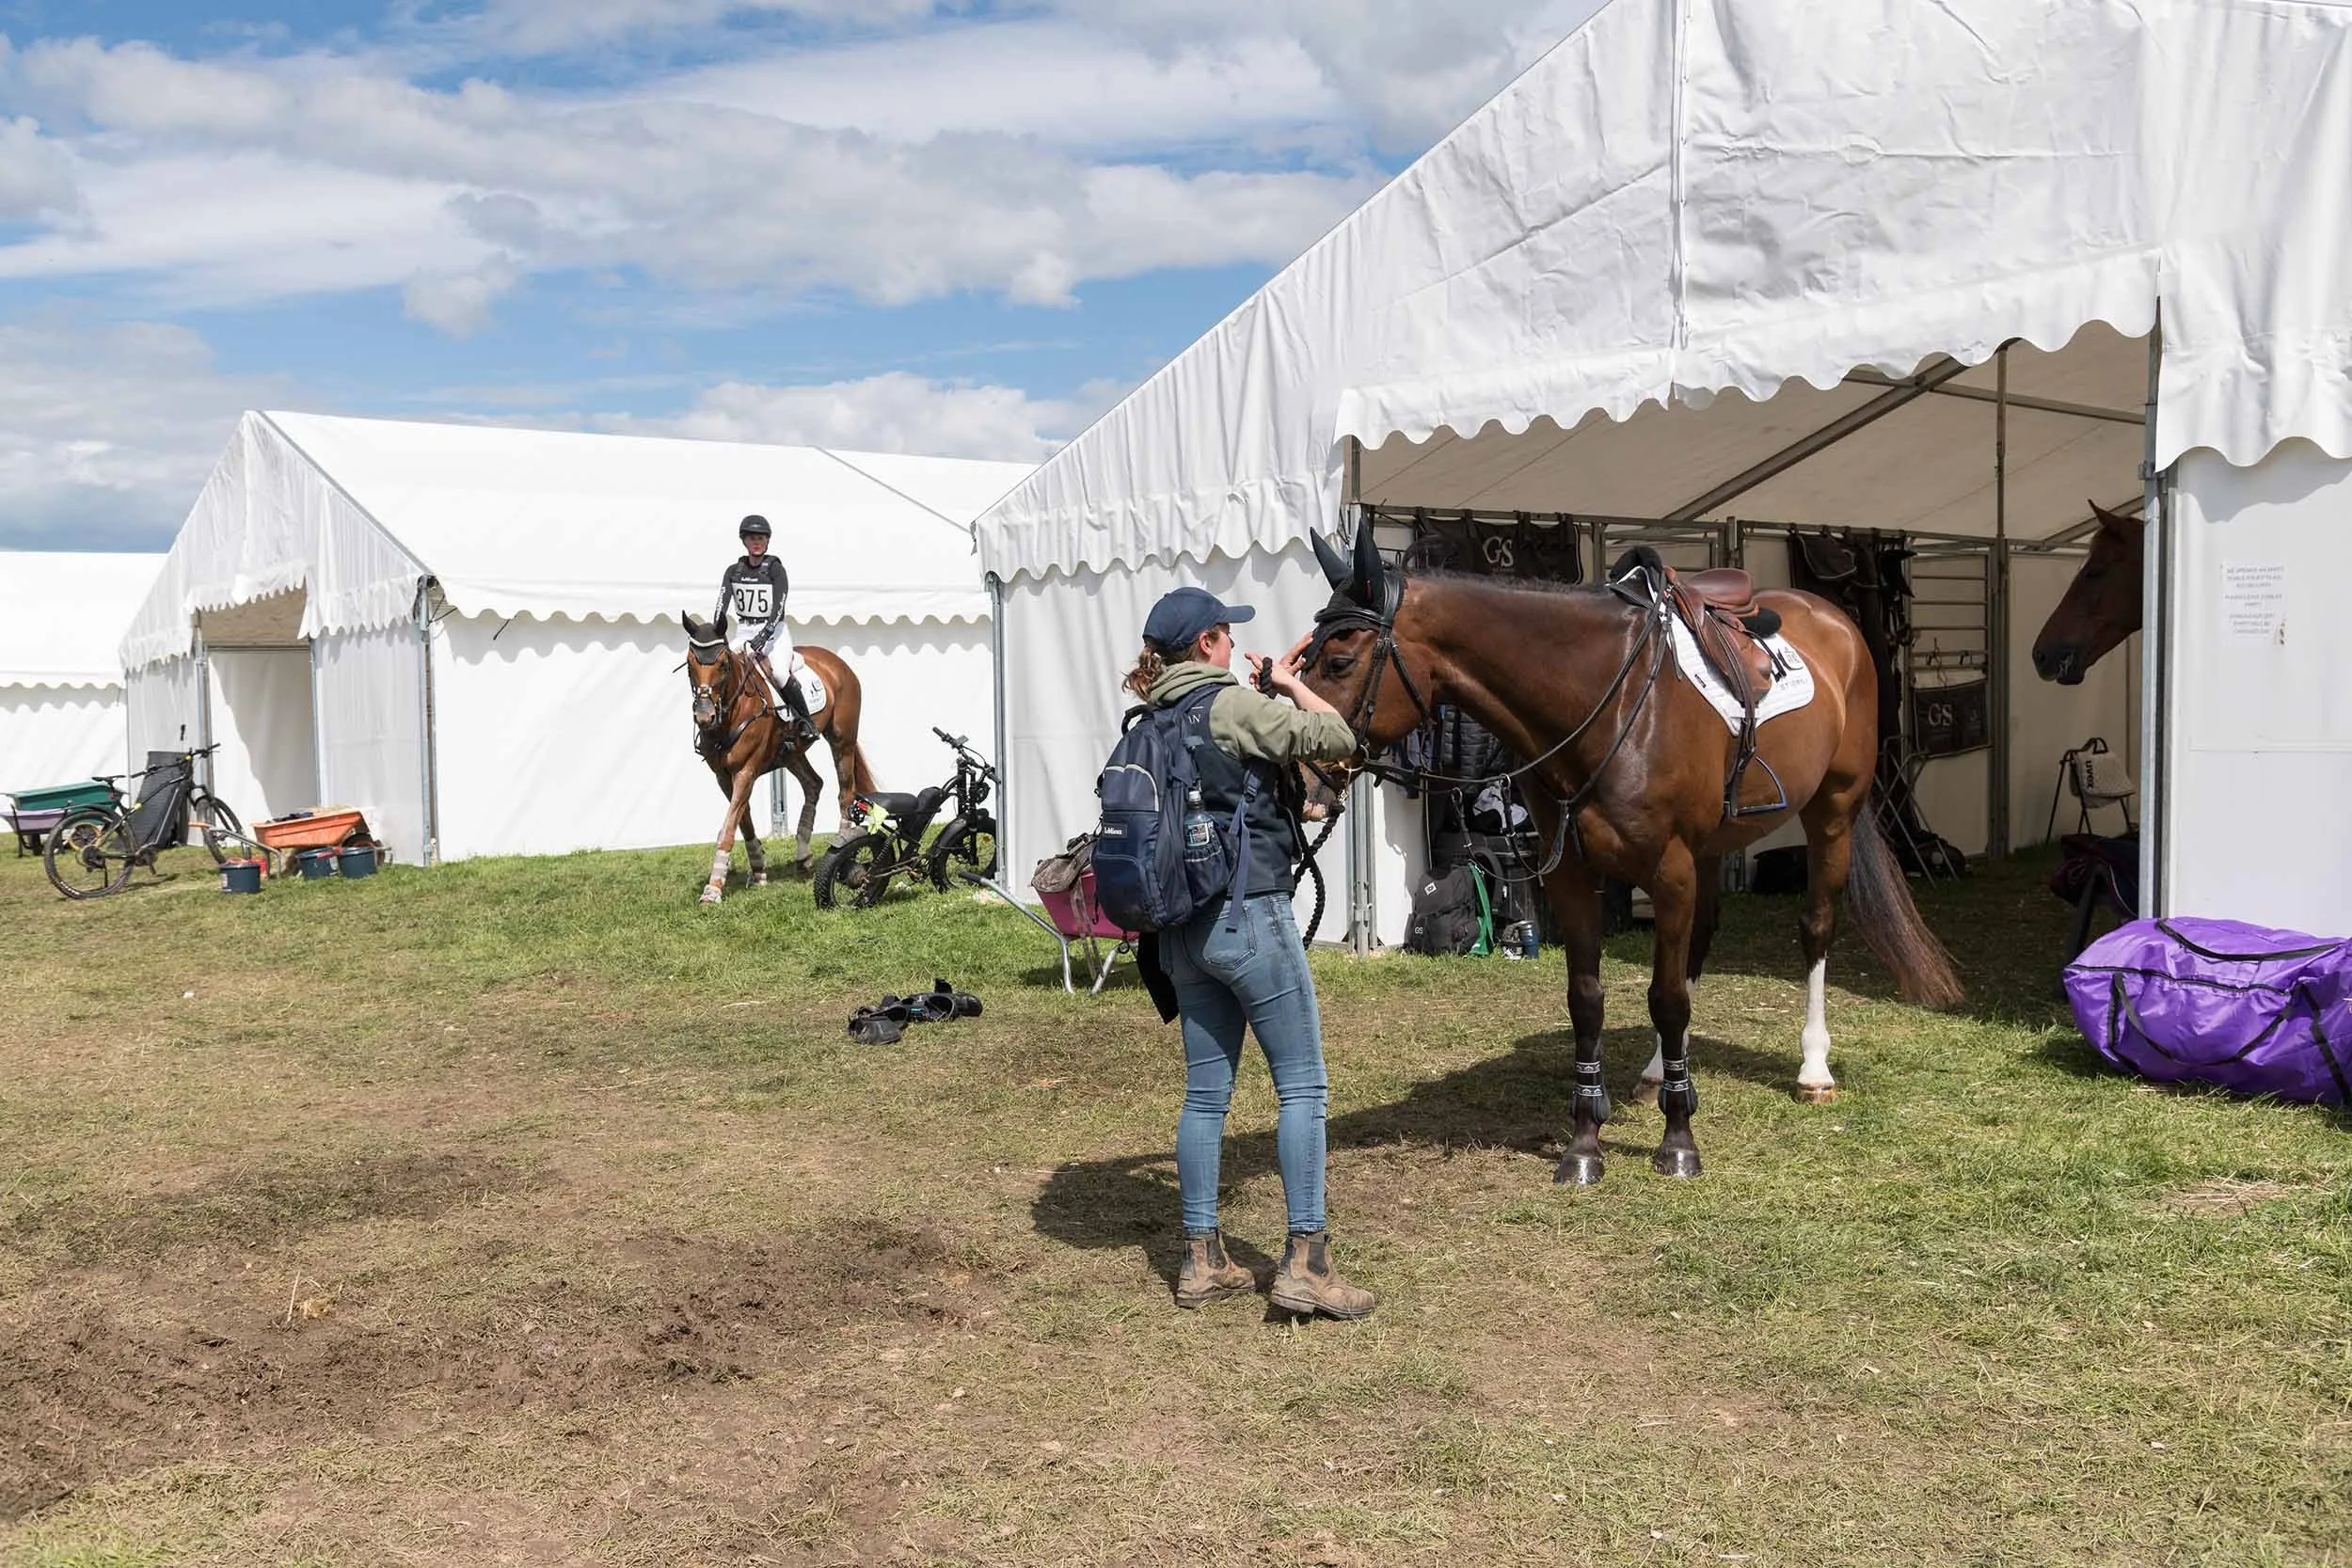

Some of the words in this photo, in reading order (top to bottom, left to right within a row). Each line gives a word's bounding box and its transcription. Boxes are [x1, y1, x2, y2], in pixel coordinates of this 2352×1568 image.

[1483, 536, 1513, 566] GS
[736, 589, 768, 612] 375
[1929, 703, 1952, 725] GS
[2085, 760, 2093, 788] uvex
